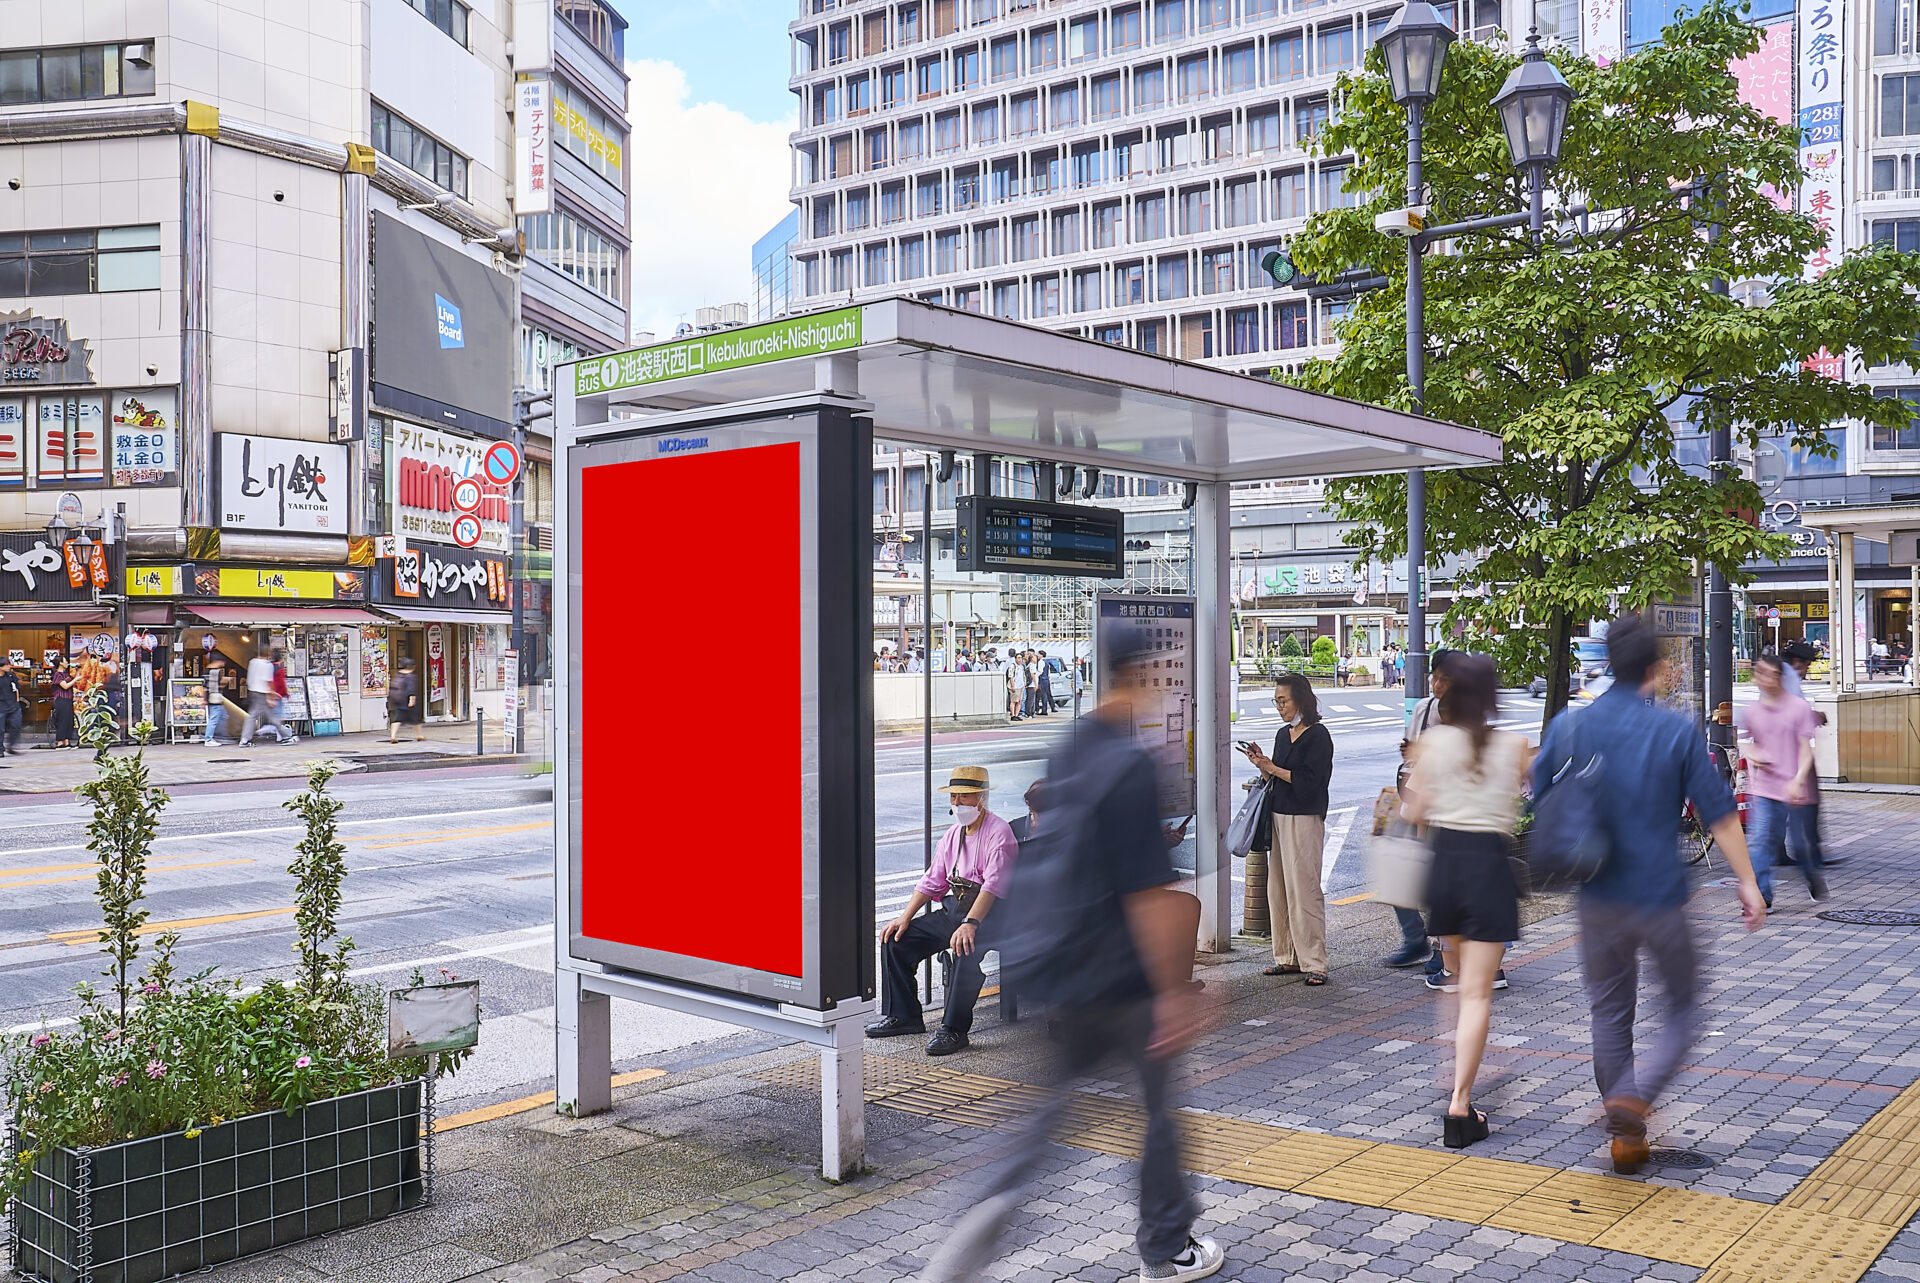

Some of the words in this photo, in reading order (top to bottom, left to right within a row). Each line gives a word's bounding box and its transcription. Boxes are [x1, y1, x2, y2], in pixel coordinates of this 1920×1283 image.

[1805, 0, 1839, 93] ろ祭り
[1812, 125, 1833, 141] 29
[531, 109, 544, 191] テナント募集
[438, 305, 455, 324] Live
[438, 319, 462, 342] Board
[707, 315, 856, 364] Ikebukuroeki-Nishiguchi
[620, 341, 704, 384] 池袋駅西口
[578, 376, 600, 393] BUS
[340, 424, 350, 438] B1
[658, 437, 709, 453] MCDecaux
[400, 456, 450, 513] mini
[460, 488, 476, 503] 40
[288, 502, 328, 512] YAKITORI
[226, 513, 245, 522] B1F
[420, 552, 488, 600] かつや
[1265, 566, 1299, 587] JR
[1304, 586, 1340, 594] Ikebukuro
[1119, 605, 1164, 616] 池袋駅西口
